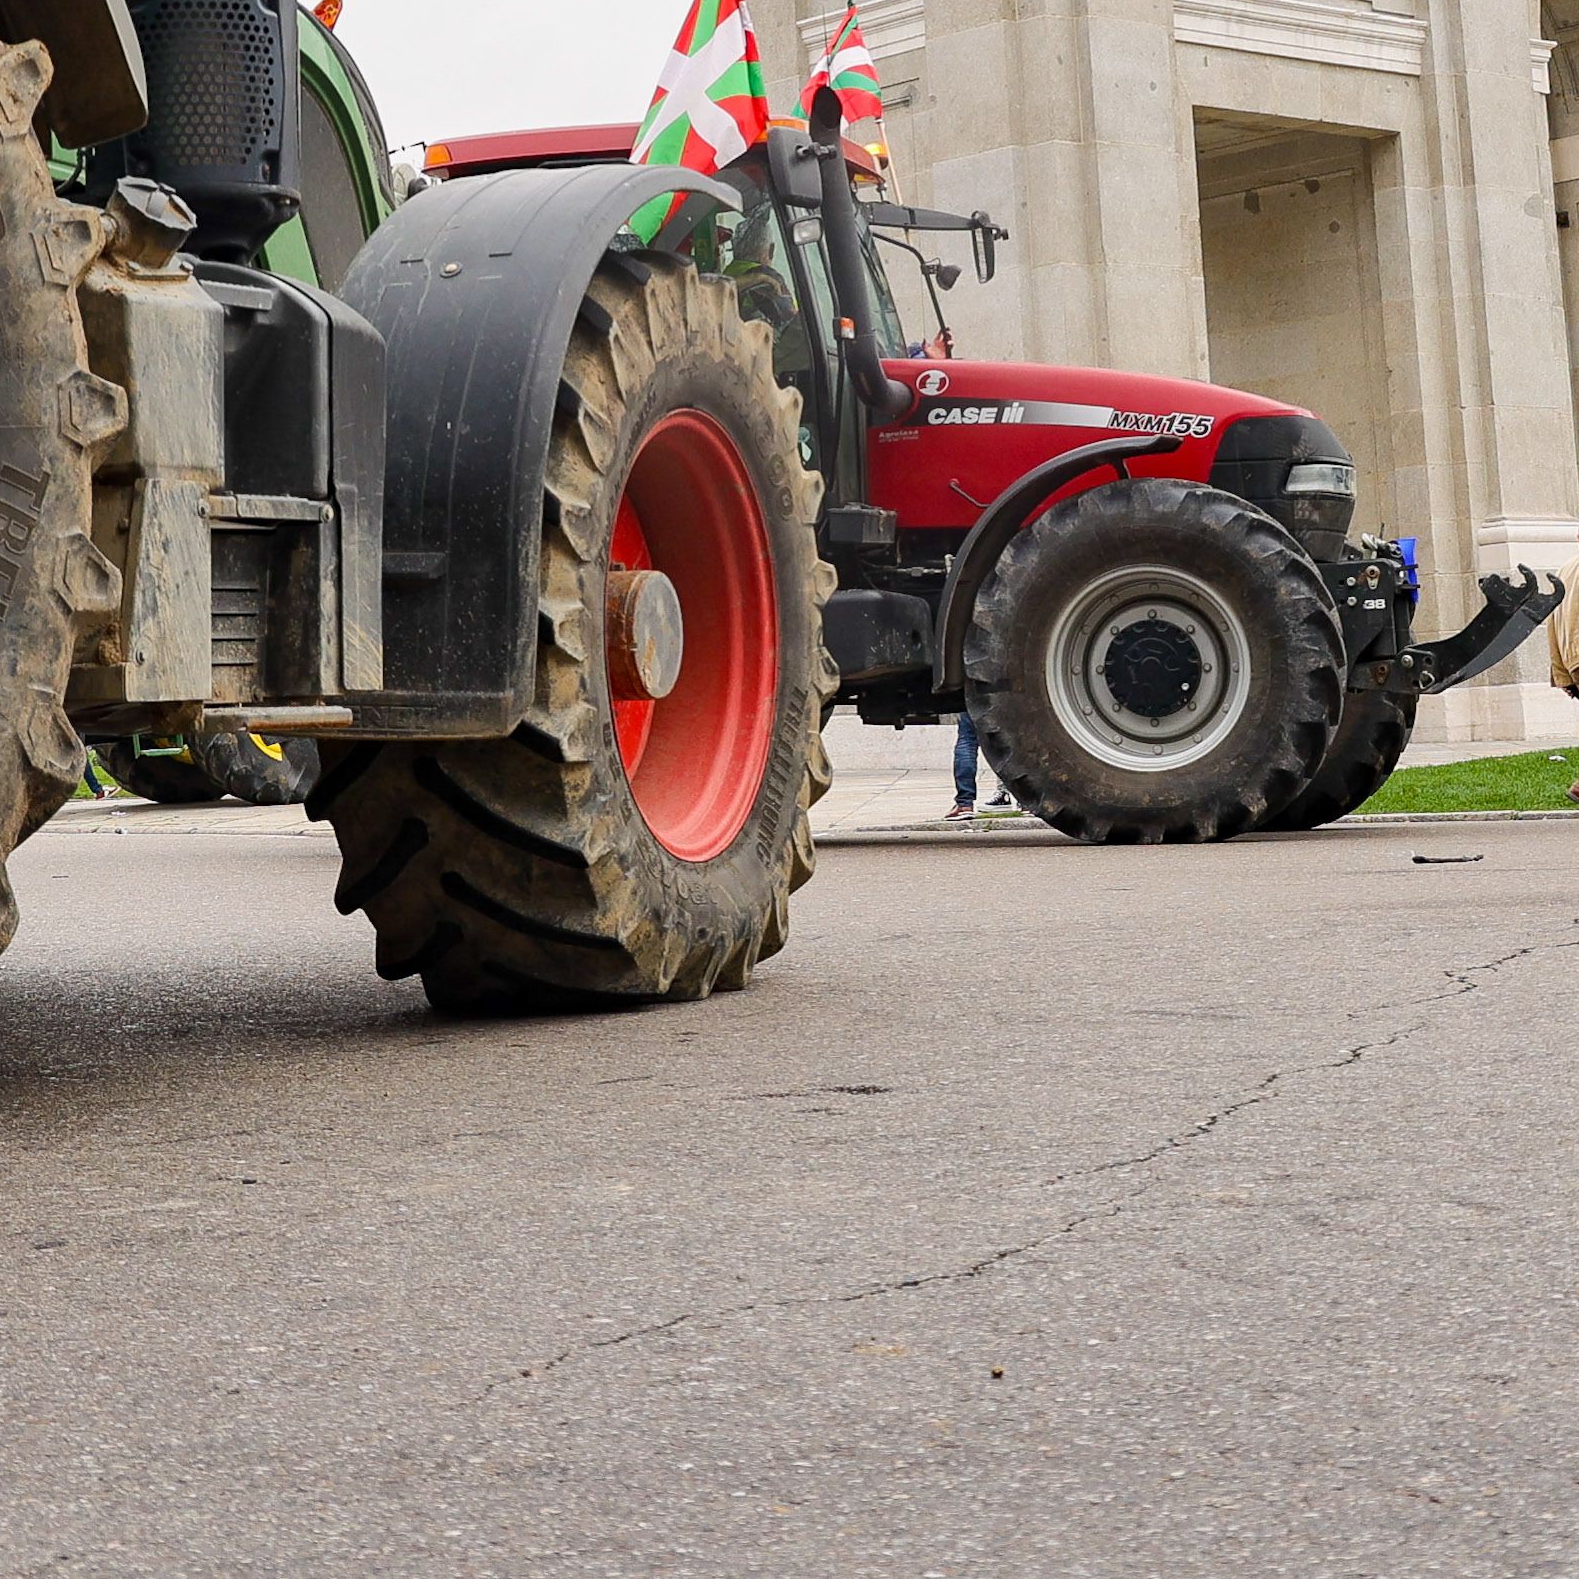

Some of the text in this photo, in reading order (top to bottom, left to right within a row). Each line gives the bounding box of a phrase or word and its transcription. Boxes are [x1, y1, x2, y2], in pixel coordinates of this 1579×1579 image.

[927, 406, 999, 426] CASE
[1110, 411, 1215, 439] MXM155
[1362, 598, 1387, 610] 38
